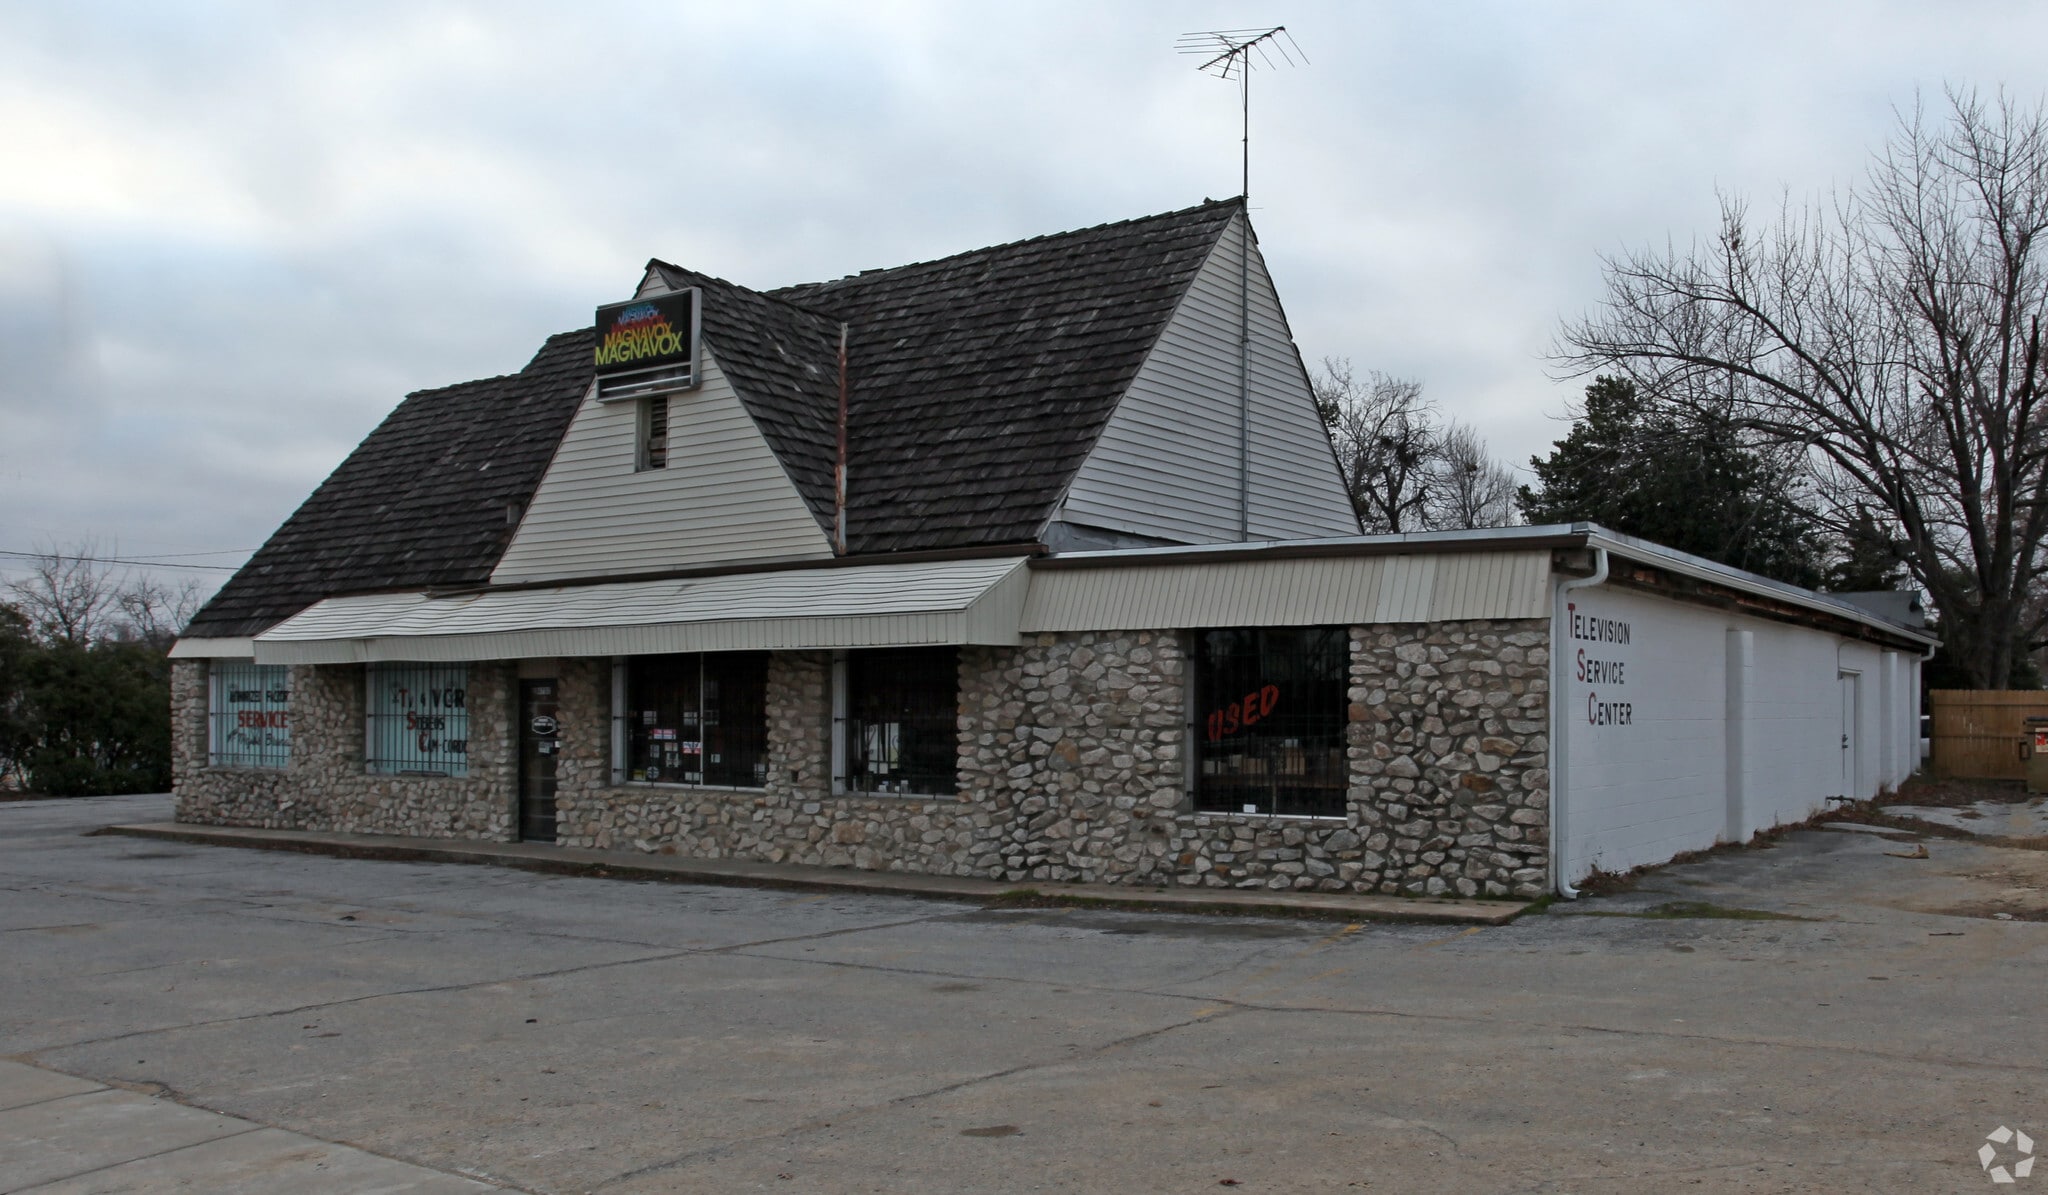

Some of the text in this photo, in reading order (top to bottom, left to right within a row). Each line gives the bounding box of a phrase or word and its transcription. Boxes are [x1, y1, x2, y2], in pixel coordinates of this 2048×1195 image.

[595, 331, 683, 366] MAGNAVOX
[1567, 603, 1631, 645] TELEVISION
[1577, 648, 1625, 685] SERVICE
[431, 687, 465, 708] VCR
[1208, 684, 1280, 742] USED
[1588, 691, 1632, 726] CENTER
[238, 710, 288, 728] SERVICE
